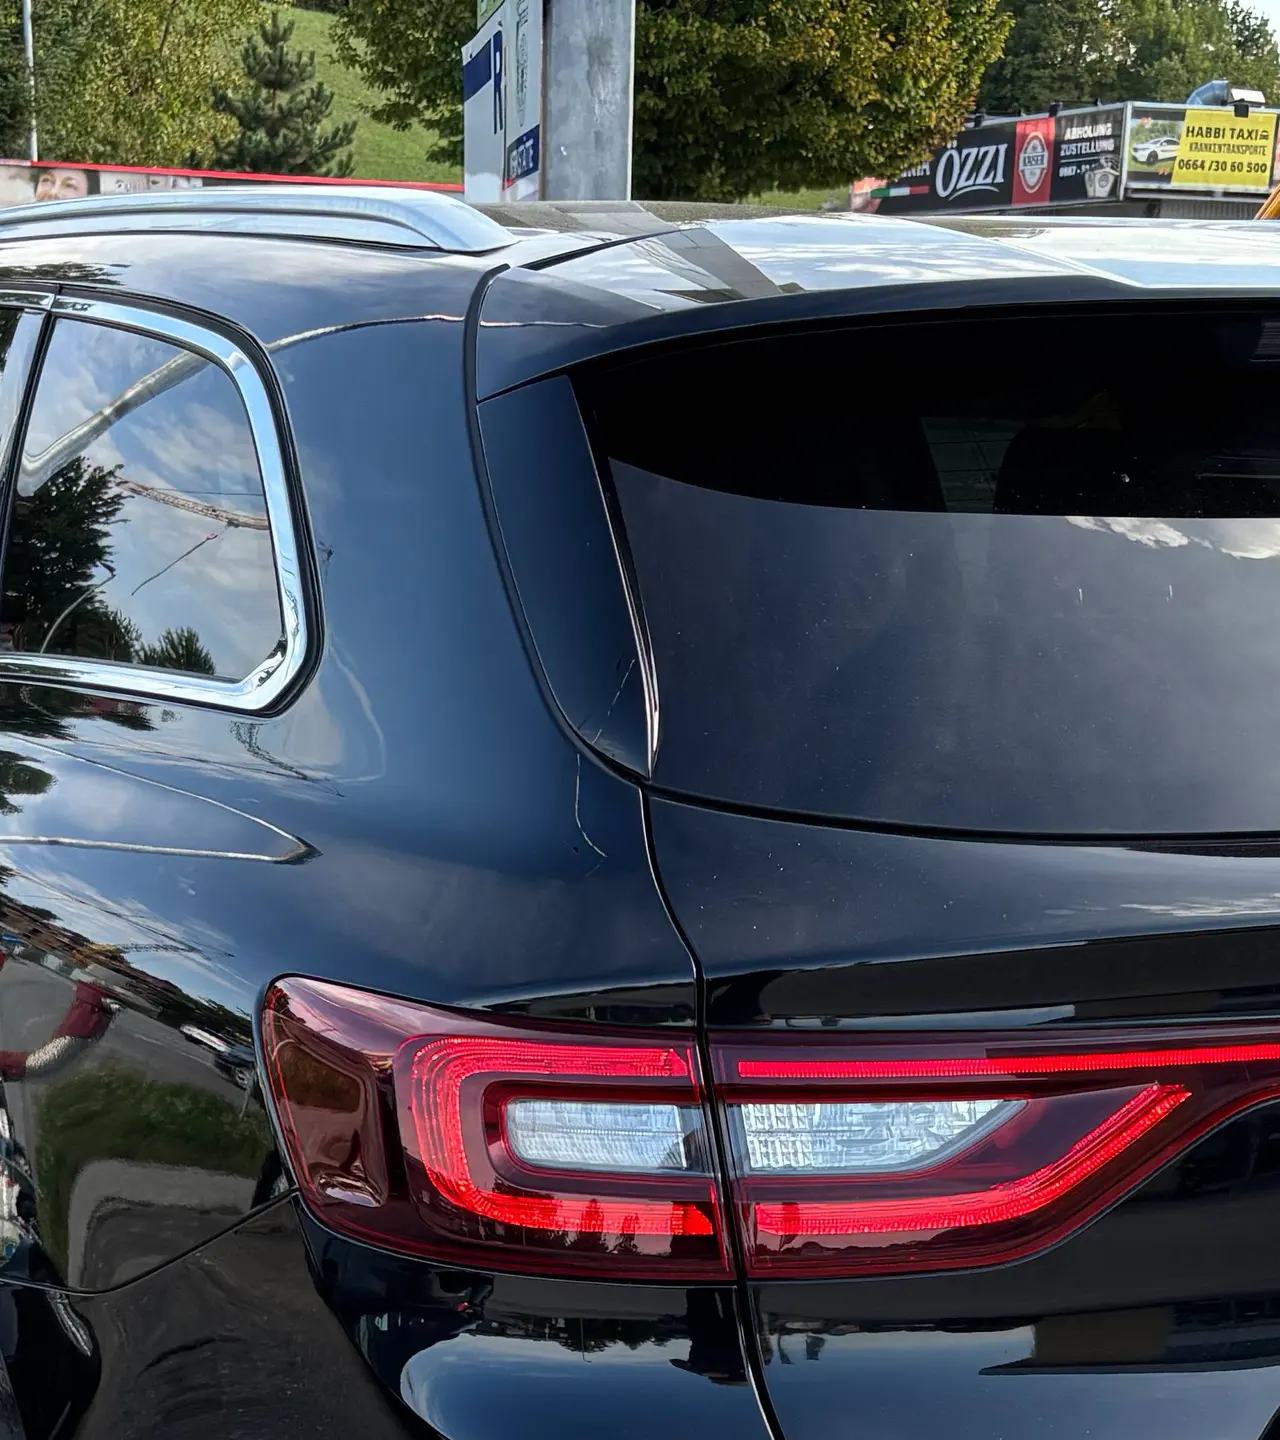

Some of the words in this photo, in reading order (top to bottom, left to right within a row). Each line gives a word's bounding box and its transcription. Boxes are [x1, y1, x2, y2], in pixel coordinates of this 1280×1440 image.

[1185, 126, 1226, 139] HABBI
[1229, 128, 1259, 141] TAXI
[1060, 139, 1114, 157] ZUSTELLUNG
[1189, 142, 1267, 156] KRANKENTRANSPORTE
[935, 134, 1008, 198] ÖZZI
[1178, 159, 1205, 171] 0664
[1230, 161, 1241, 172] 60
[1246, 163, 1267, 173] 500
